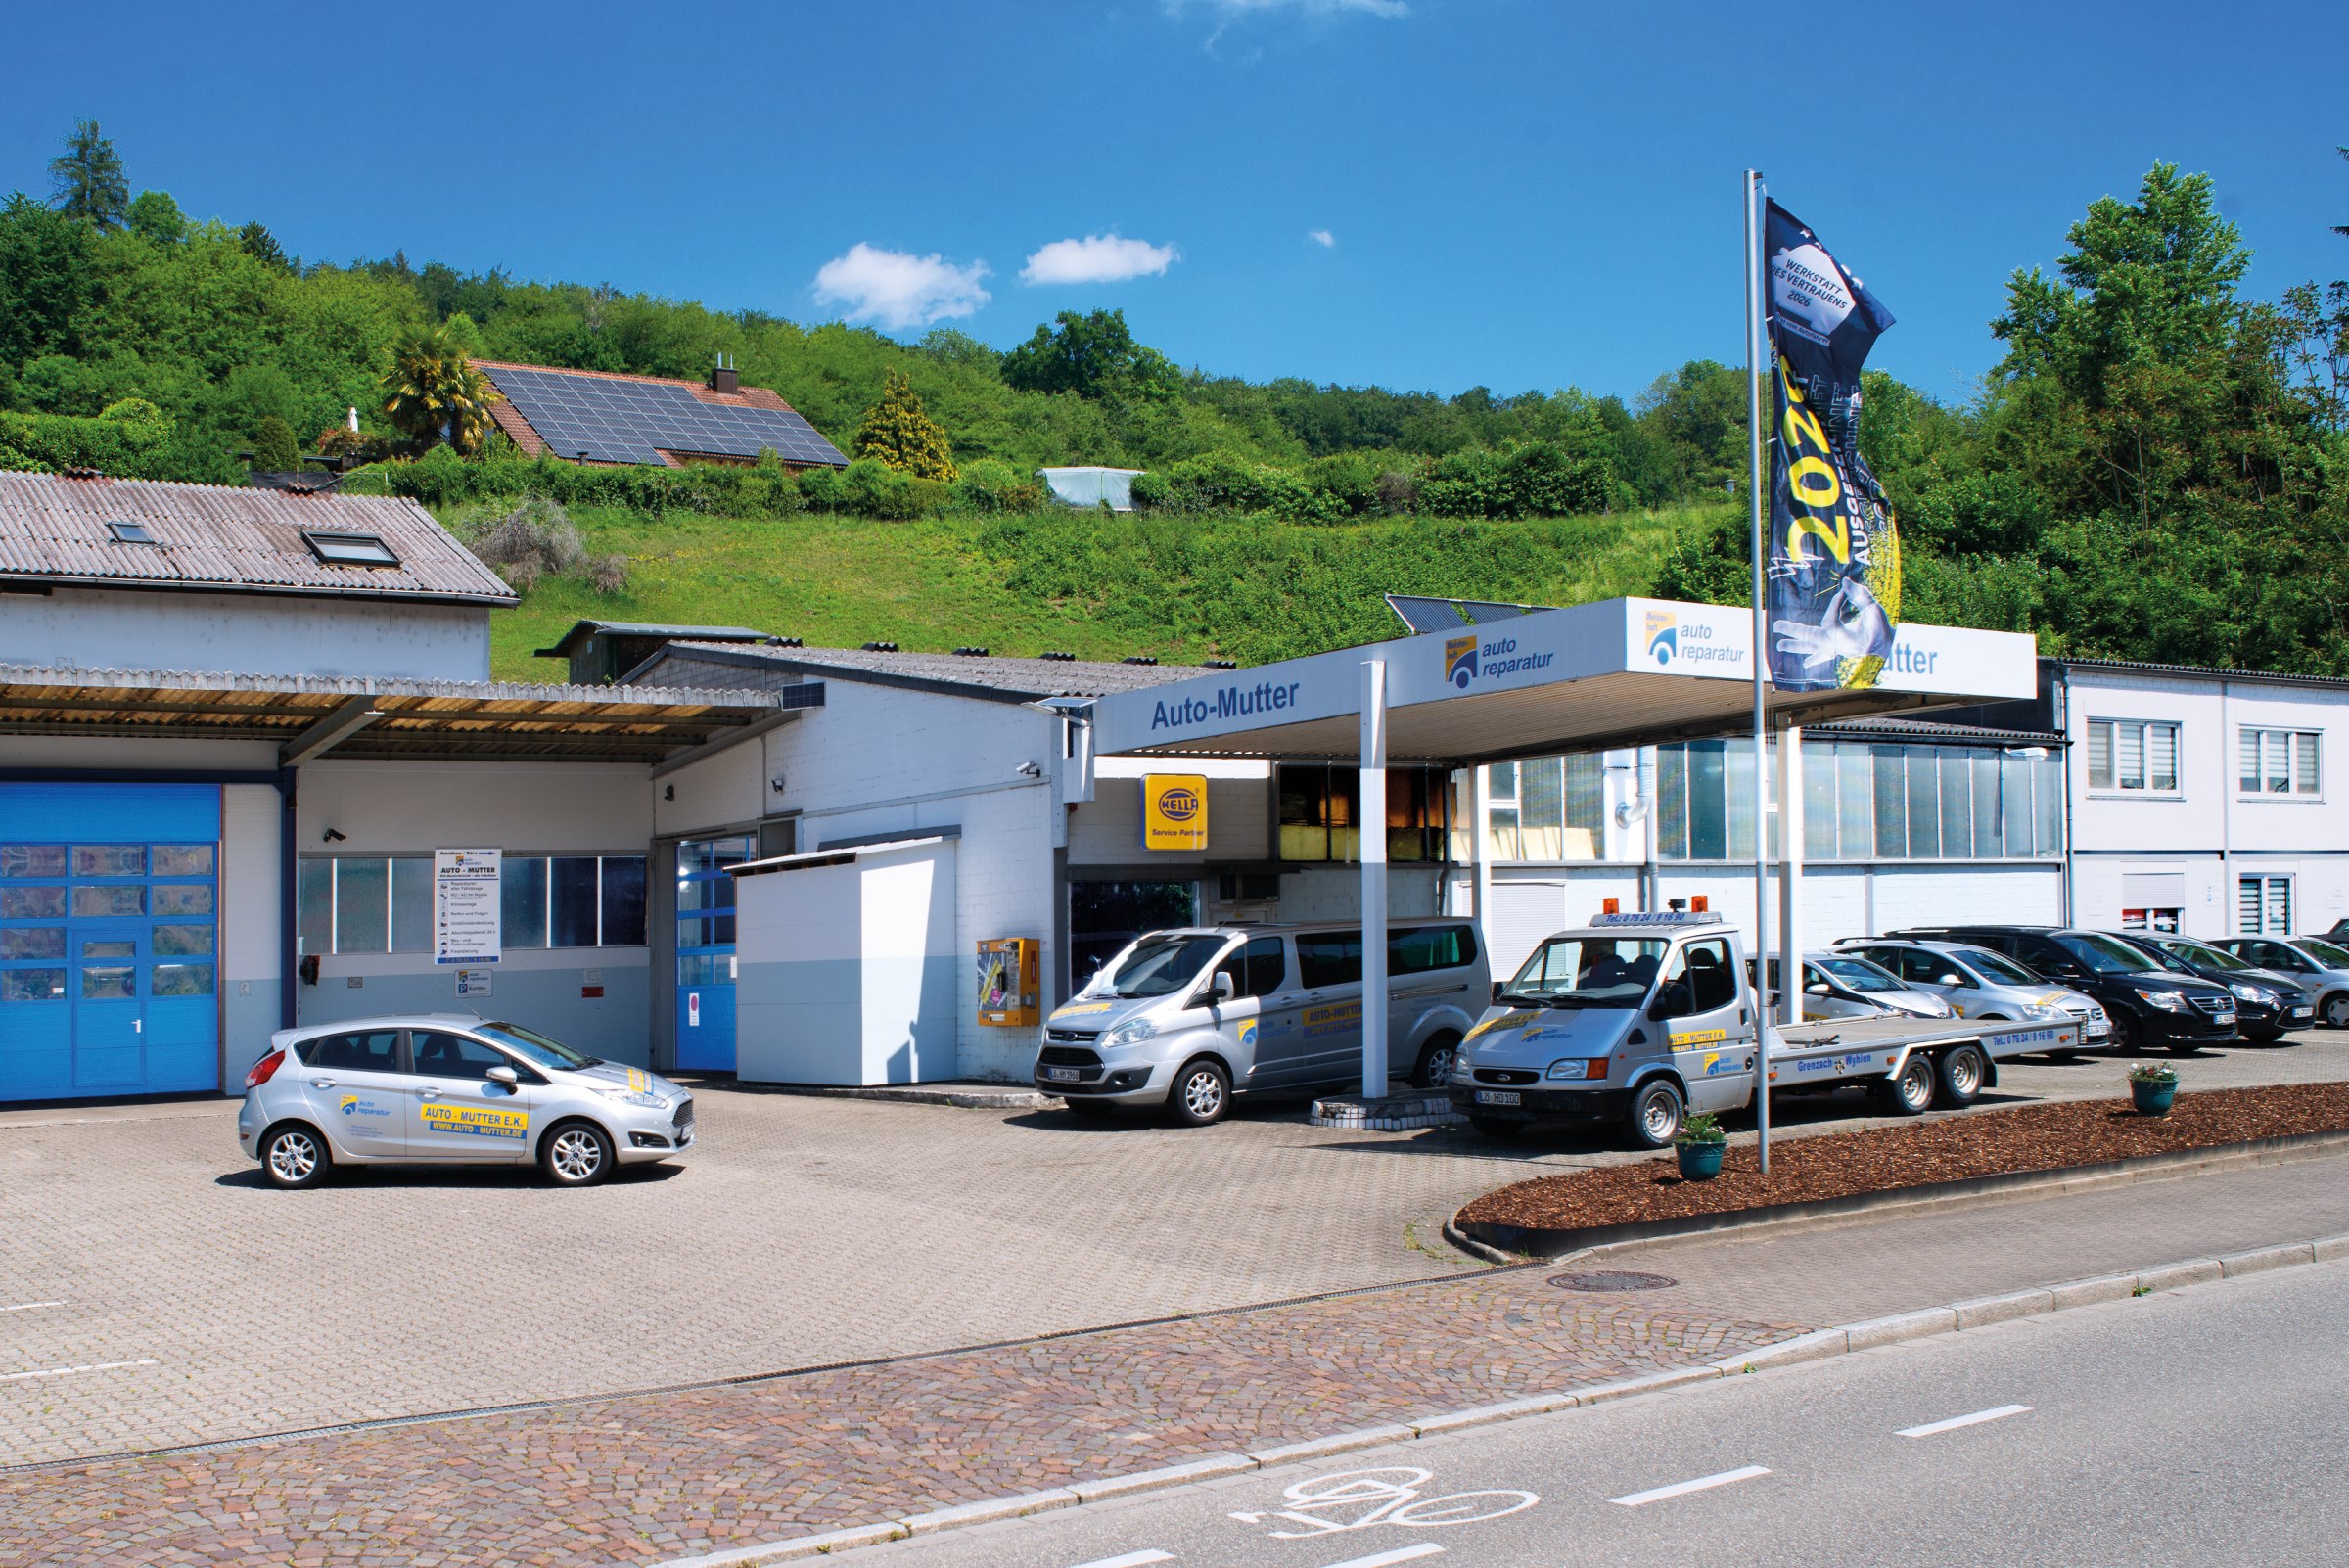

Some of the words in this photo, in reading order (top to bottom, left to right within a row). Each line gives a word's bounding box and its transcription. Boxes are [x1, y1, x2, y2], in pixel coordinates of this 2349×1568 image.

[1785, 258, 1843, 295] WERKSTATT
[1771, 265, 1787, 280] DES
[1787, 273, 1848, 309] VERTRAUENS
[1786, 290, 1812, 307] 2026
[1681, 624, 1712, 639] auto
[1482, 637, 1517, 658] auto
[1681, 645, 1744, 664] reparatur
[1482, 652, 1554, 679] reparatur
[1881, 642, 1938, 675] utter
[1151, 681, 1301, 730] Auto-Mutter
[1162, 798, 1198, 811] HELLA
[1152, 828, 1177, 837] Service
[1310, 1004, 1362, 1022] AUTO-MUTTE
[1993, 1036, 2006, 1046] Tel.:
[2007, 1035, 2011, 1045] 0
[2012, 1034, 2020, 1044] 76
[2021, 1033, 2028, 1043] 24
[2033, 1032, 2036, 1042] 9
[2038, 1031, 2045, 1041] 16
[2046, 1030, 2054, 1040] 90
[1798, 1058, 1832, 1072] Grenzach
[1845, 1053, 1871, 1068] Wyhlen
[1481, 1092, 1490, 1102] LÖ
[1494, 1093, 1504, 1103] HD
[1505, 1094, 1519, 1104] 100
[358, 1108, 391, 1116] reparatur
[425, 1107, 452, 1119] AUTO
[460, 1111, 501, 1124] MUTTER
[504, 1114, 524, 1127] E.K.
[432, 1121, 475, 1134] WWW.AUTO
[479, 1127, 523, 1138] MUTTER.DE
